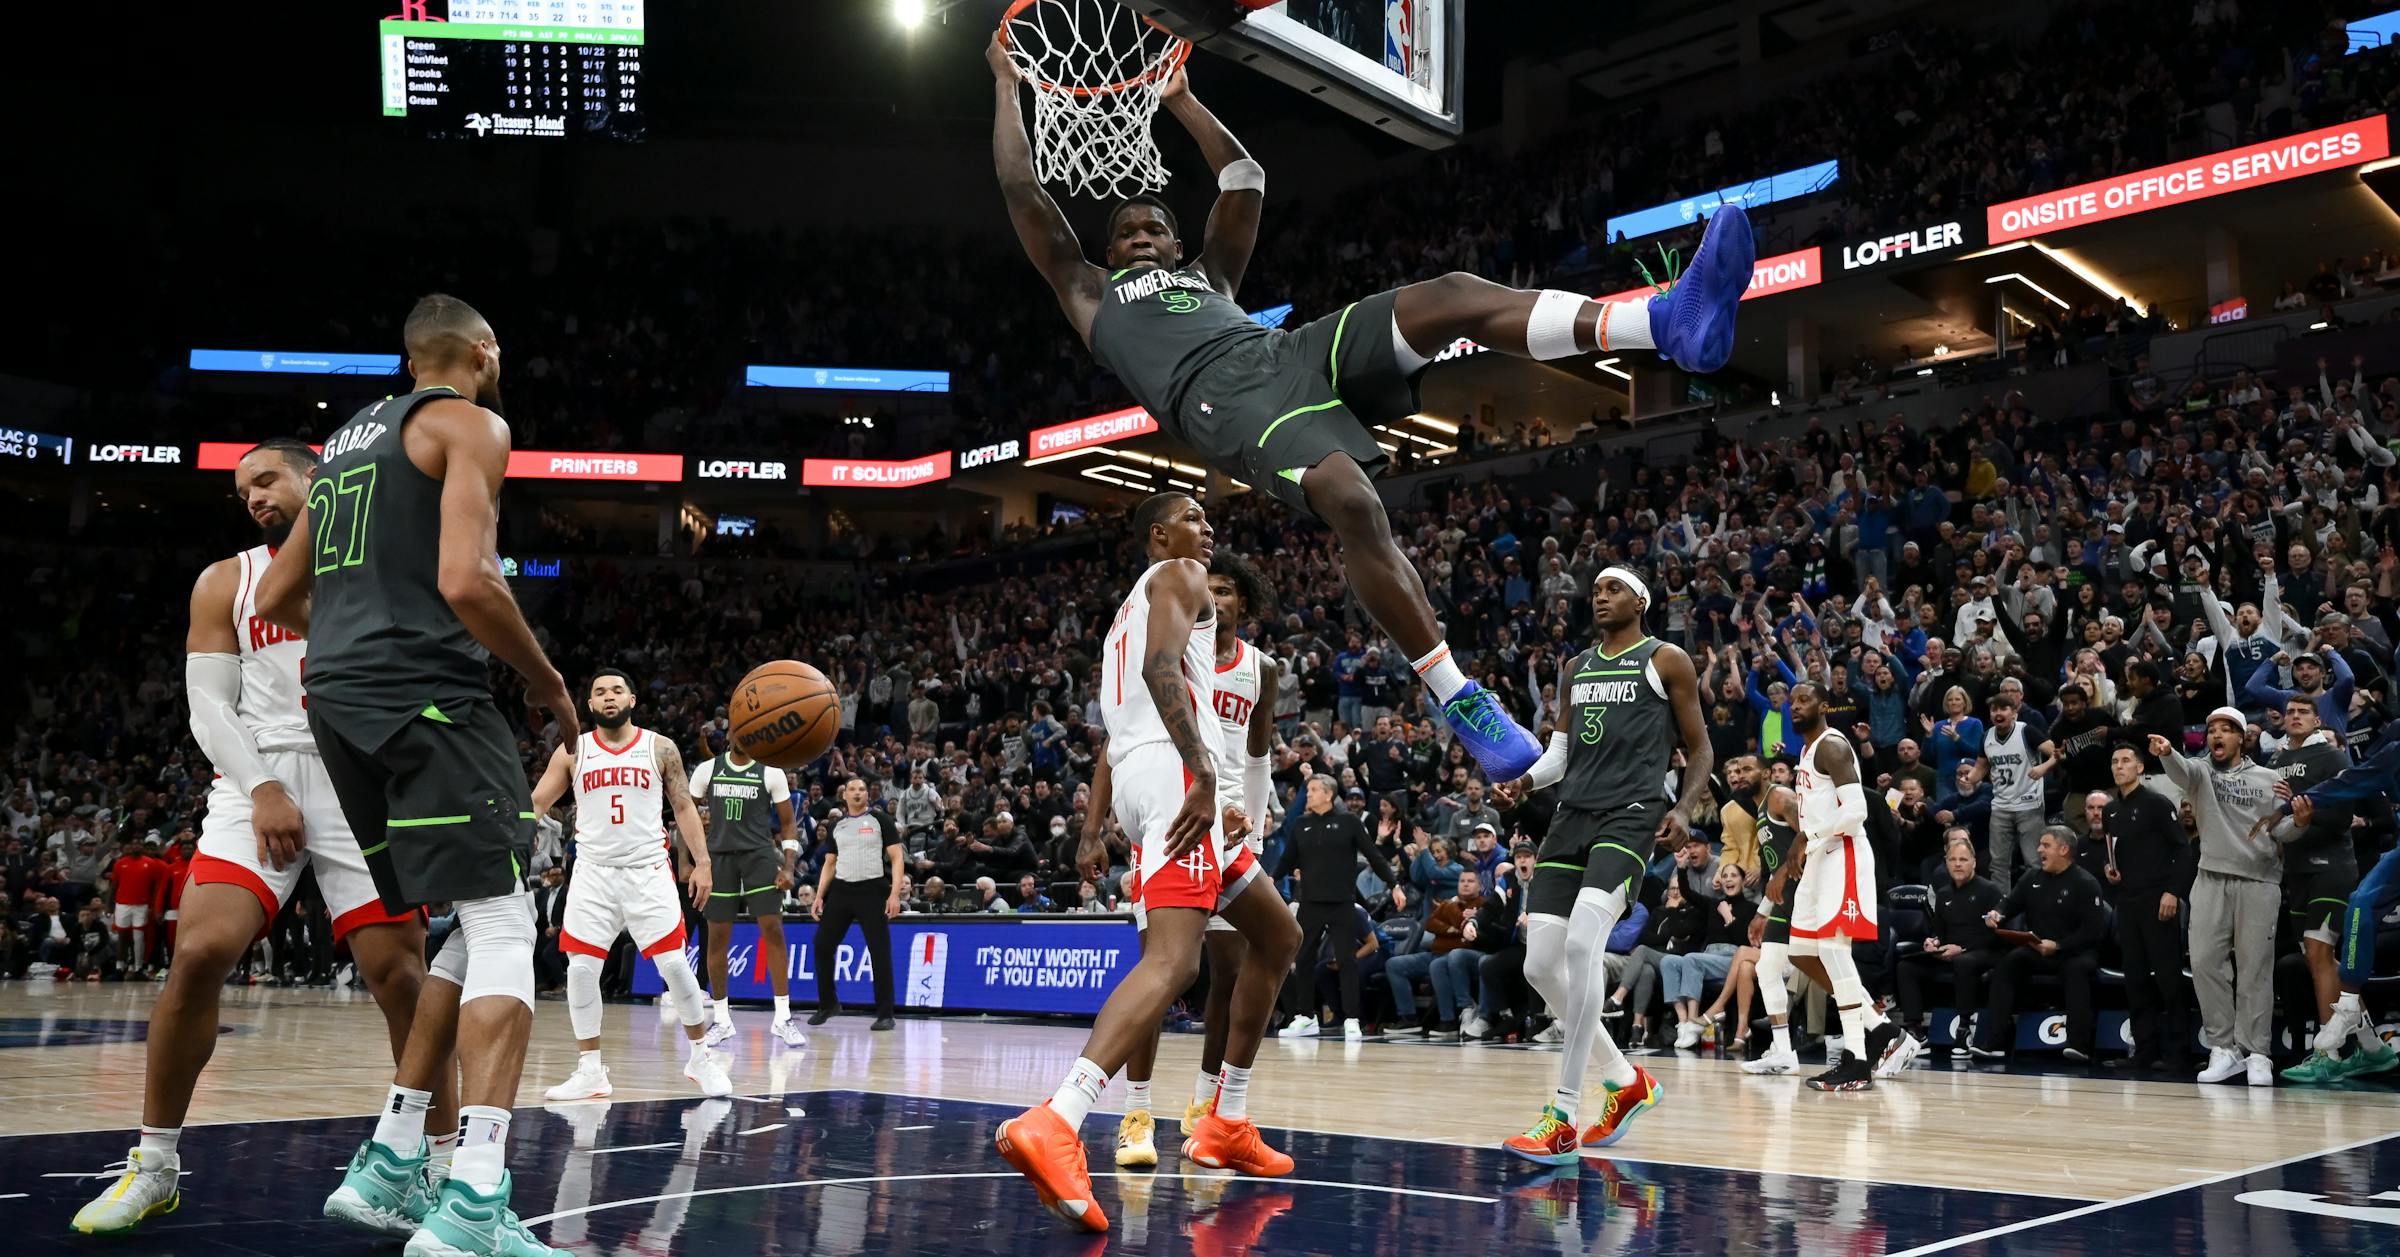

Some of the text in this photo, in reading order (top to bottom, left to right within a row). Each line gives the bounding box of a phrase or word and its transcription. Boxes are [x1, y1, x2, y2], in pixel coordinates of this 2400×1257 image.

[500, 11, 518, 20] 71.4
[528, 12, 540, 21] 35
[552, 14, 564, 22] 22
[577, 14, 588, 23] 12
[407, 40, 436, 51] Green
[505, 44, 517, 54] 26
[560, 46, 567, 55] 3
[578, 46, 605, 56] 10/22
[617, 48, 639, 57] 2/11
[407, 54, 449, 65] VanVleet
[506, 58, 517, 67] 19
[560, 59, 568, 69] 3
[582, 61, 605, 70] 8/17
[618, 62, 640, 71] 3/10
[1388, 54, 1402, 73] NBA
[408, 68, 442, 78] Brooks
[525, 72, 531, 81] 1
[545, 73, 550, 81] 1
[560, 73, 568, 82] 4
[583, 74, 600, 83] 2/6
[620, 75, 635, 85] 1/4
[408, 81, 436, 92] Smith
[437, 82, 450, 92] Jr.
[506, 86, 518, 95] 15
[524, 85, 532, 95] 9
[561, 87, 568, 97] 3
[620, 89, 635, 98] 1/7
[409, 95, 438, 105] Green
[545, 100, 550, 109] 1
[562, 101, 568, 110] 1
[584, 102, 602, 111] 3/5
[619, 102, 636, 112] 2/4
[491, 113, 565, 130] Treasure Island
[2001, 132, 2362, 232] ONSITE OFFICE SERVICES
[1843, 221, 1963, 270] LOFFLER
[1158, 290, 1201, 314] 5
[28, 434, 38, 446] 0
[1038, 411, 1149, 451] CYBER SECURITY
[0, 441, 63, 459] SAC 0 1
[90, 444, 181, 463] LOFFLER
[960, 440, 1020, 469] LOFFLER
[551, 458, 638, 474] PRINTERS
[698, 460, 787, 480] LOFFLER
[832, 462, 934, 481] IT SOLUTIONS
[307, 463, 376, 576] 27
[523, 559, 561, 577] Island
[1580, 706, 1607, 744] 3
[1989, 753, 2022, 767] WOLVES
[583, 767, 651, 794] ROCKETS
[1998, 768, 2015, 786] 32
[713, 783, 759, 800] TIMBERWOLVES
[611, 794, 624, 824] 5
[725, 798, 743, 820] 11
[976, 945, 1120, 968] IT'S ONLY WORTH IT
[985, 966, 1106, 988] IF YOU ENJOY IT
